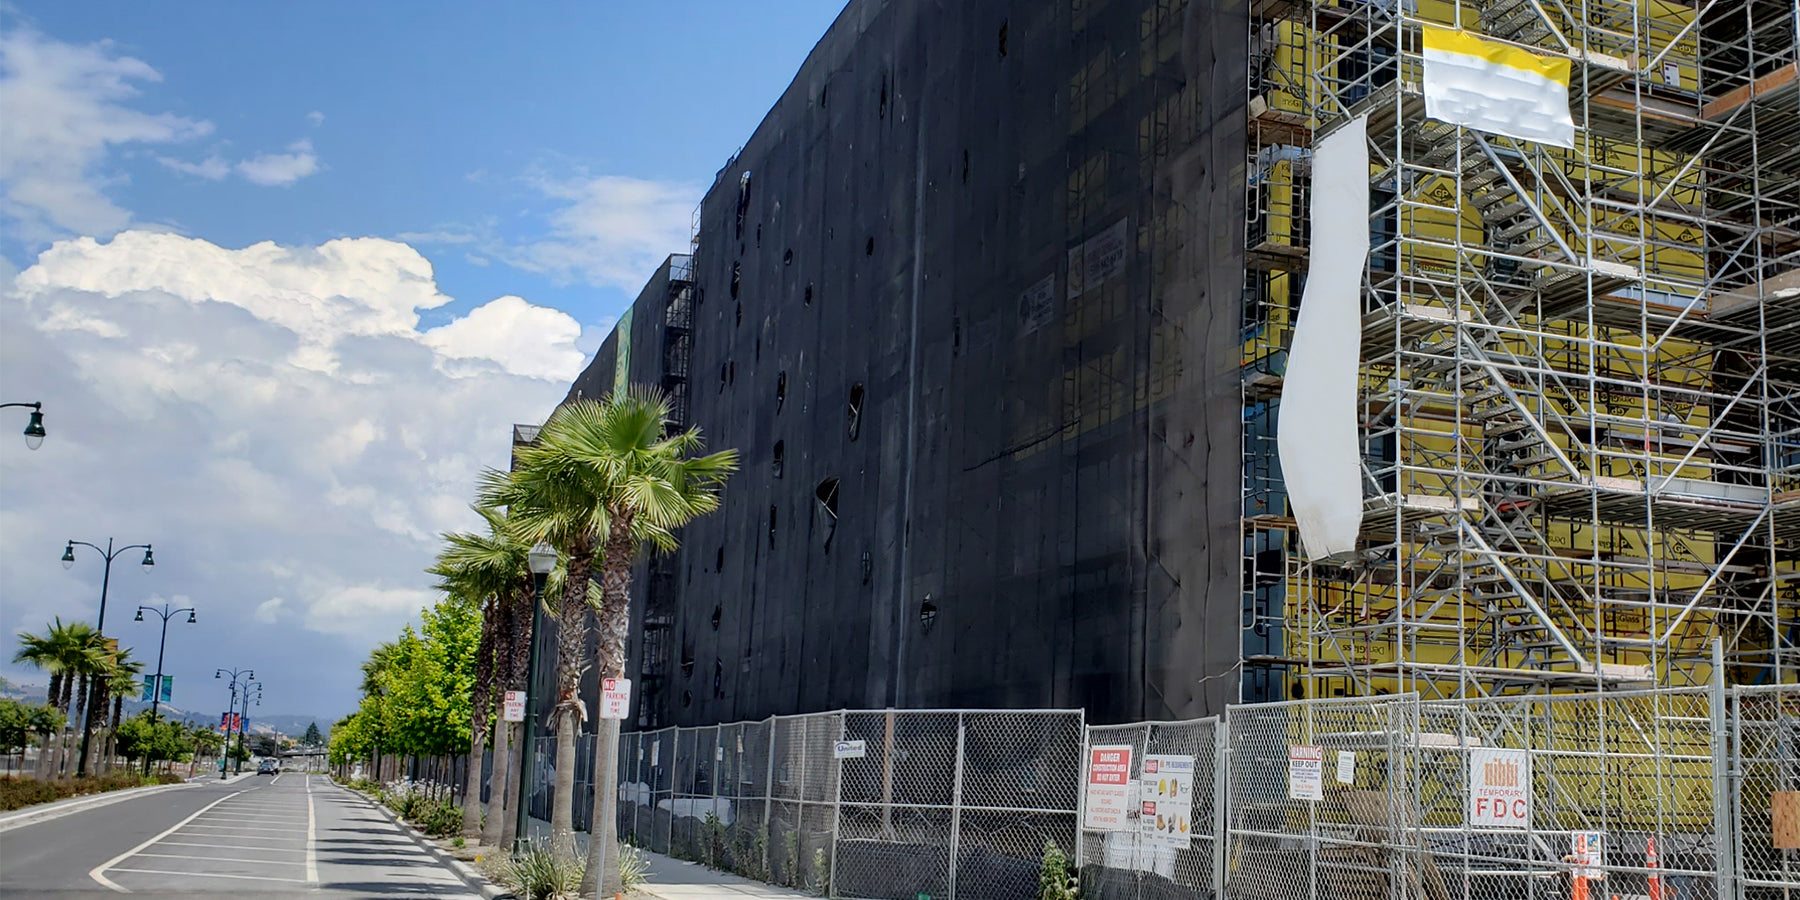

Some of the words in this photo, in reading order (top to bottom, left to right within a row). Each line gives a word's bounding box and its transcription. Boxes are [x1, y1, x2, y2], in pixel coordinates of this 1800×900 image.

[1434, 188, 1449, 198] GP
[604, 680, 615, 690] NO
[506, 692, 515, 701] NO
[606, 692, 628, 700] PARKING
[1100, 752, 1121, 762] DANGER
[1291, 746, 1321, 759] WARNING
[1484, 757, 1519, 787] nibbi
[1479, 788, 1524, 797] TEMPORARY
